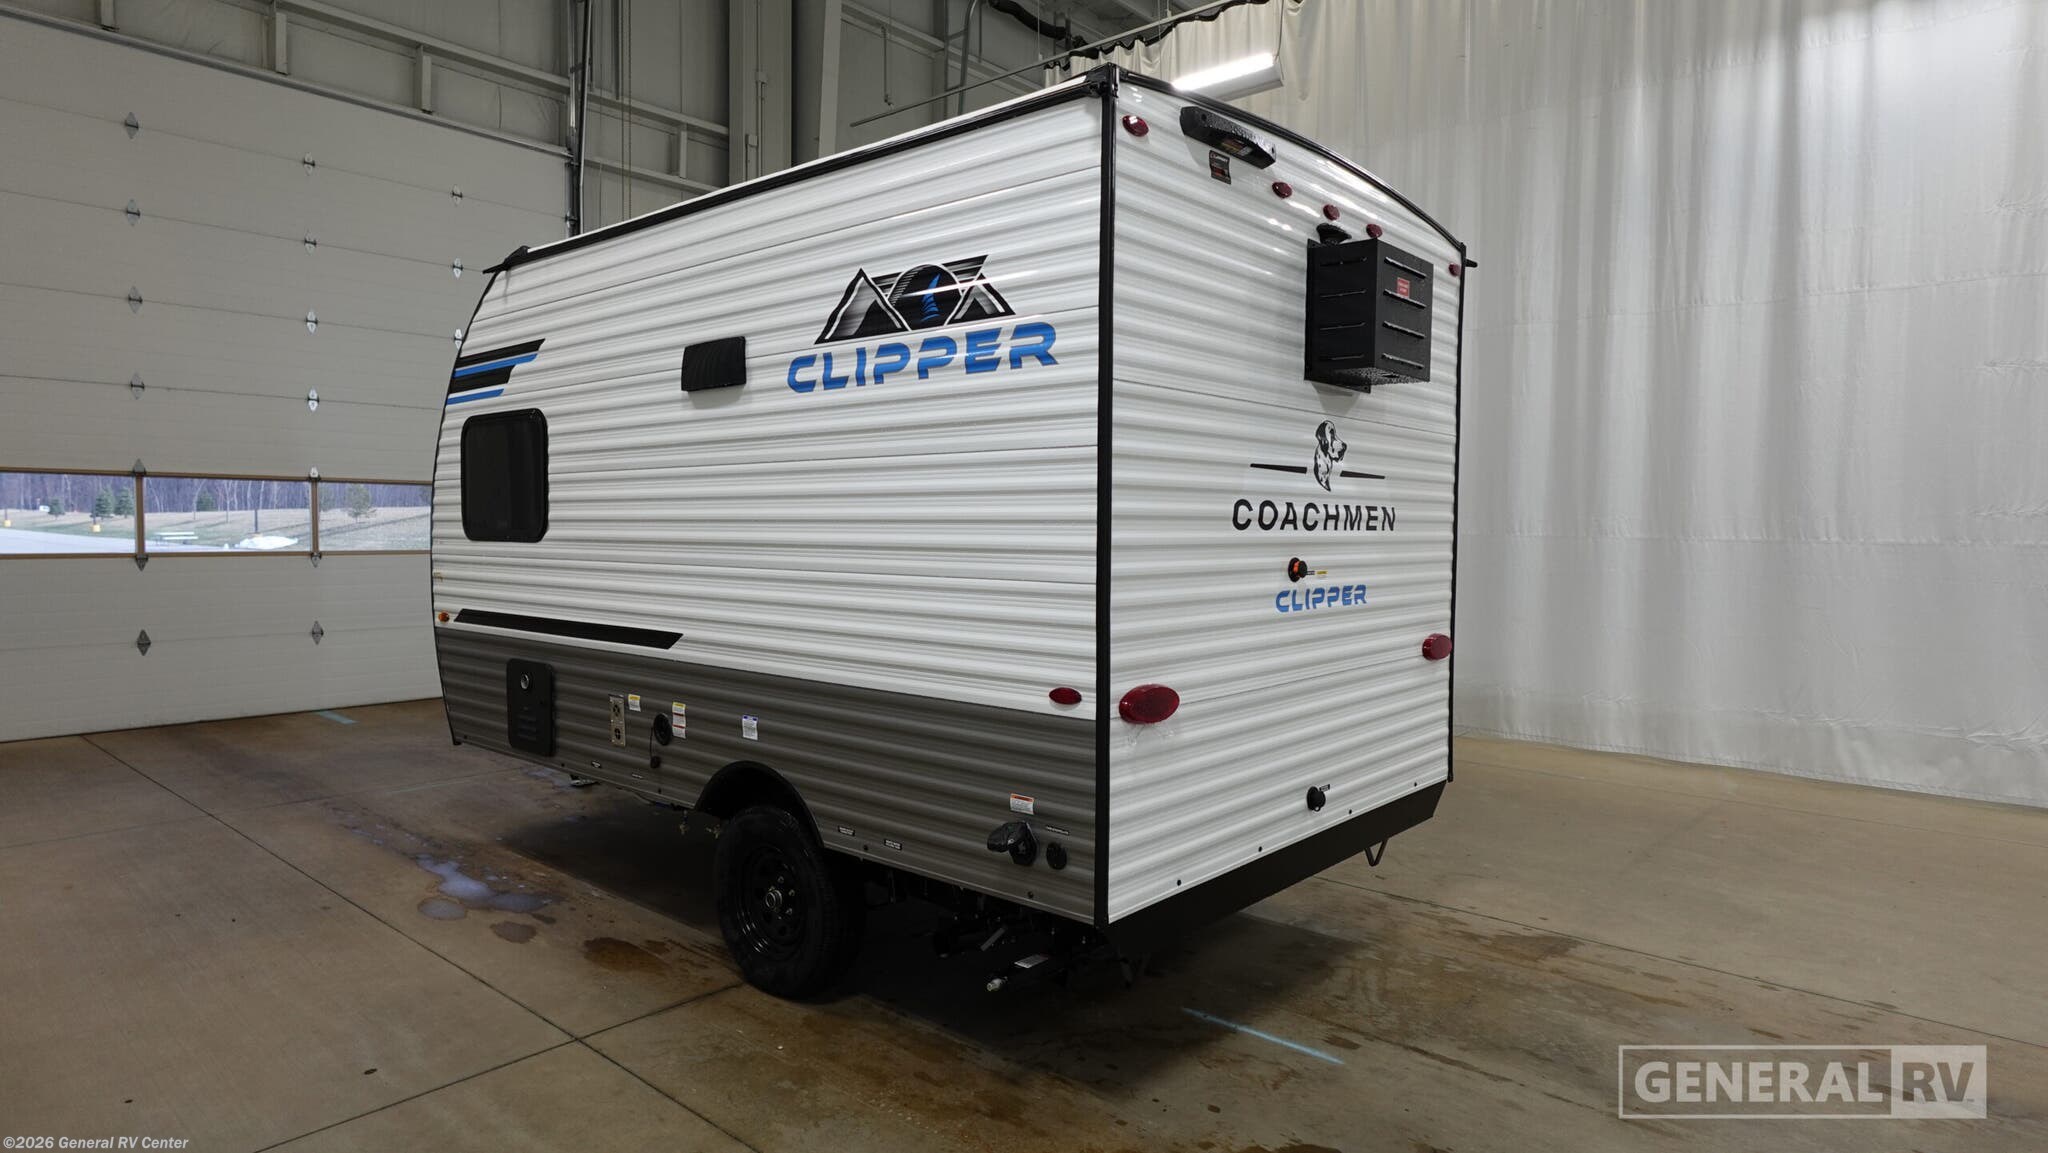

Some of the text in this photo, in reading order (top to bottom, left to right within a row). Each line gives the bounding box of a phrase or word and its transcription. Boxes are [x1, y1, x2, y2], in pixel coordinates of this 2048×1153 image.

[787, 321, 1059, 393] CLIPPER
[1232, 499, 1396, 532] COACHMEN
[1275, 584, 1367, 613] CLIPPER
